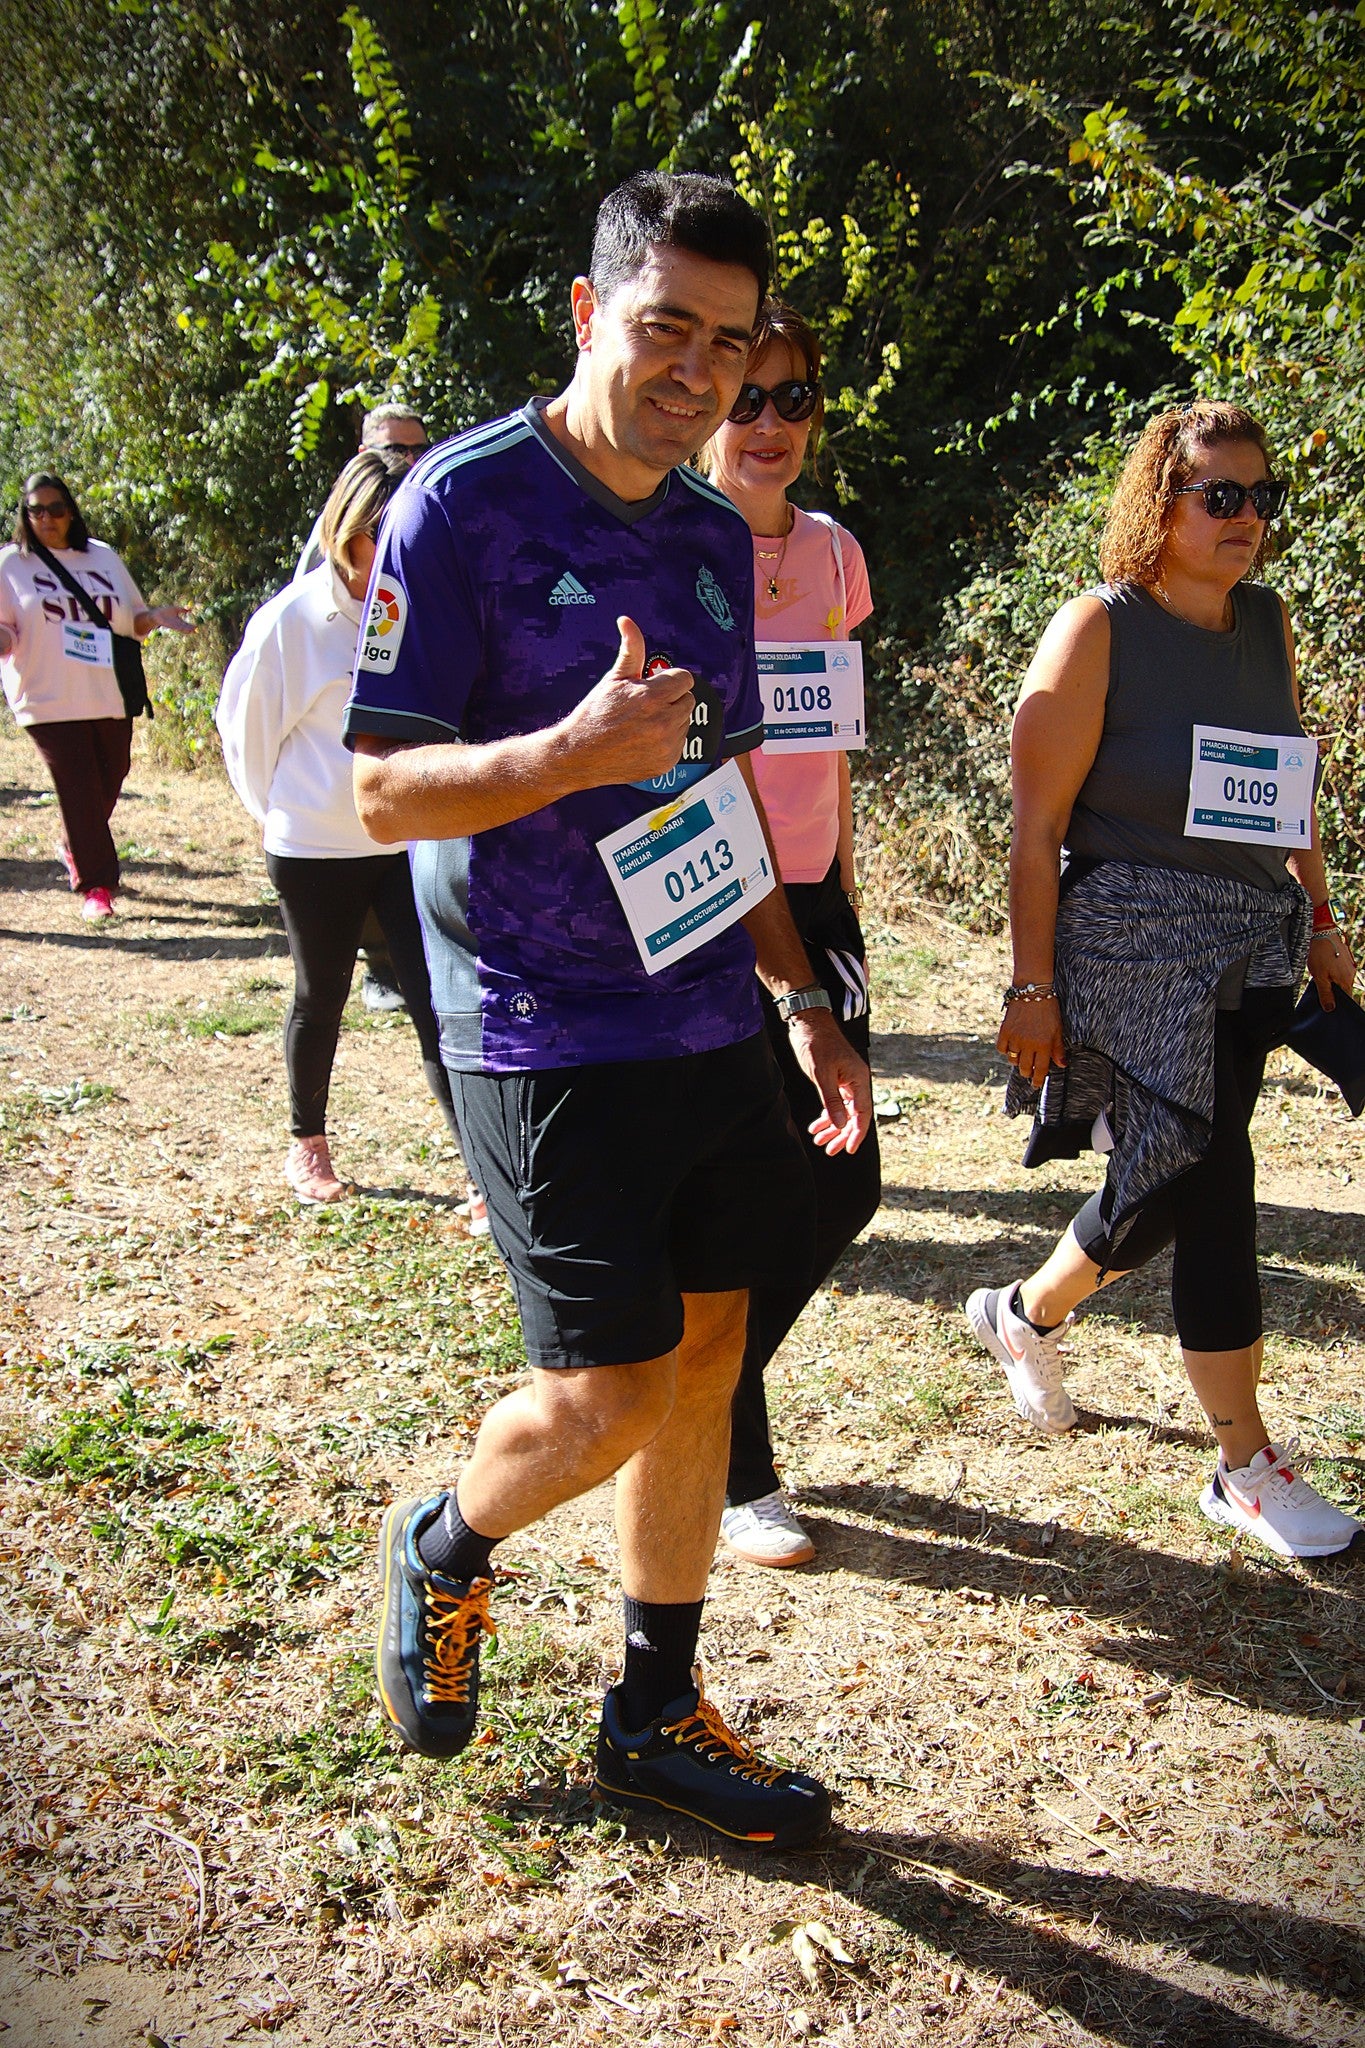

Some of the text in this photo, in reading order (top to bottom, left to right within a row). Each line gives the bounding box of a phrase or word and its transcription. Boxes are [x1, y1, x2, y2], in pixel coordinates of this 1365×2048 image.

[548, 593, 596, 606] adidas
[774, 685, 832, 712] 0108
[1201, 750, 1226, 760] FAMILIAR
[1206, 741, 1229, 750] MARCHA
[1224, 776, 1278, 806] 0109
[1234, 818, 1254, 826] OCTUBRE
[620, 837, 650, 860] MARCHA
[649, 816, 686, 842] SOLIDARIA
[620, 851, 652, 874] FAMILIAR
[664, 839, 734, 903] 0113
[660, 932, 671, 943] KM
[679, 922, 687, 931] 11
[686, 917, 694, 926] de
[694, 902, 719, 922] OCTUBRE
[718, 897, 726, 906] de
[724, 889, 737, 902] 2025
